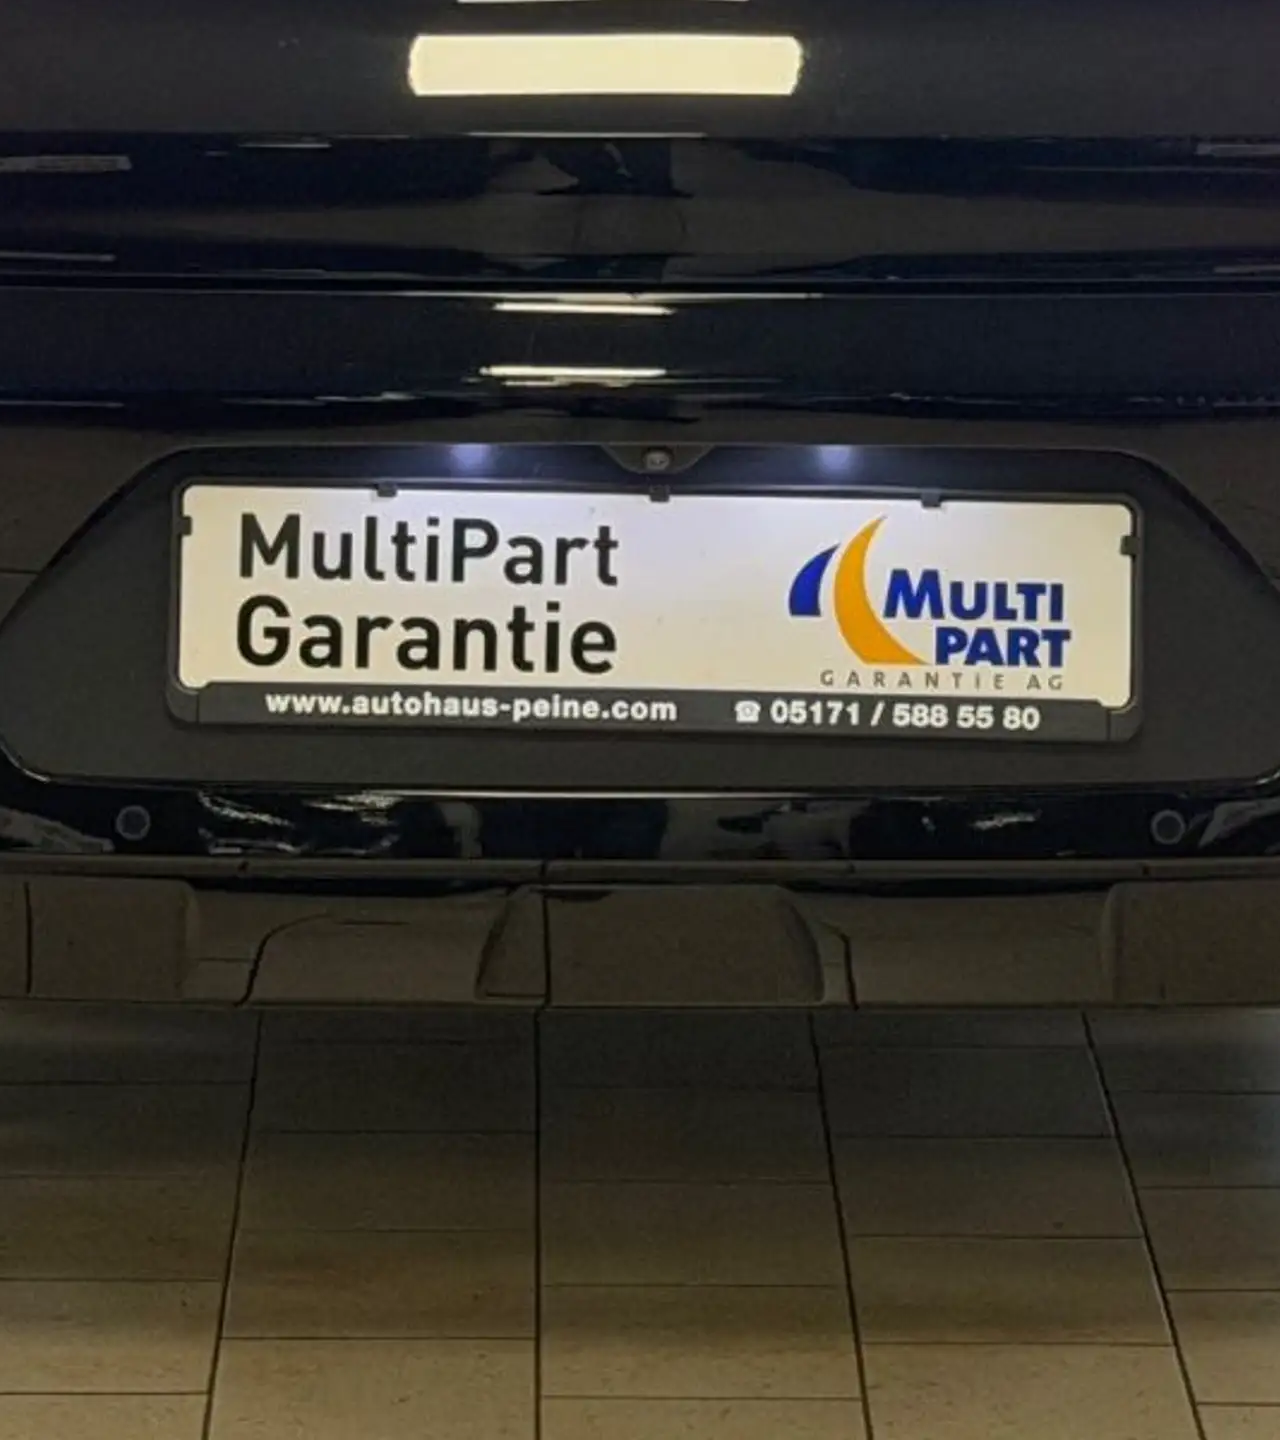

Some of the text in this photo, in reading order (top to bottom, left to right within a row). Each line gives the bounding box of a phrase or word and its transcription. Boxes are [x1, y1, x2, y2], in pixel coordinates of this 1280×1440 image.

[239, 512, 619, 587] MultiPart
[236, 593, 618, 675] Garantie
[934, 626, 1072, 668] PART
[819, 669, 1064, 691] GARANTIE AG
[264, 690, 678, 722] www.autohaus-peine.com
[770, 699, 1041, 731] 05171 / 588 55 80
